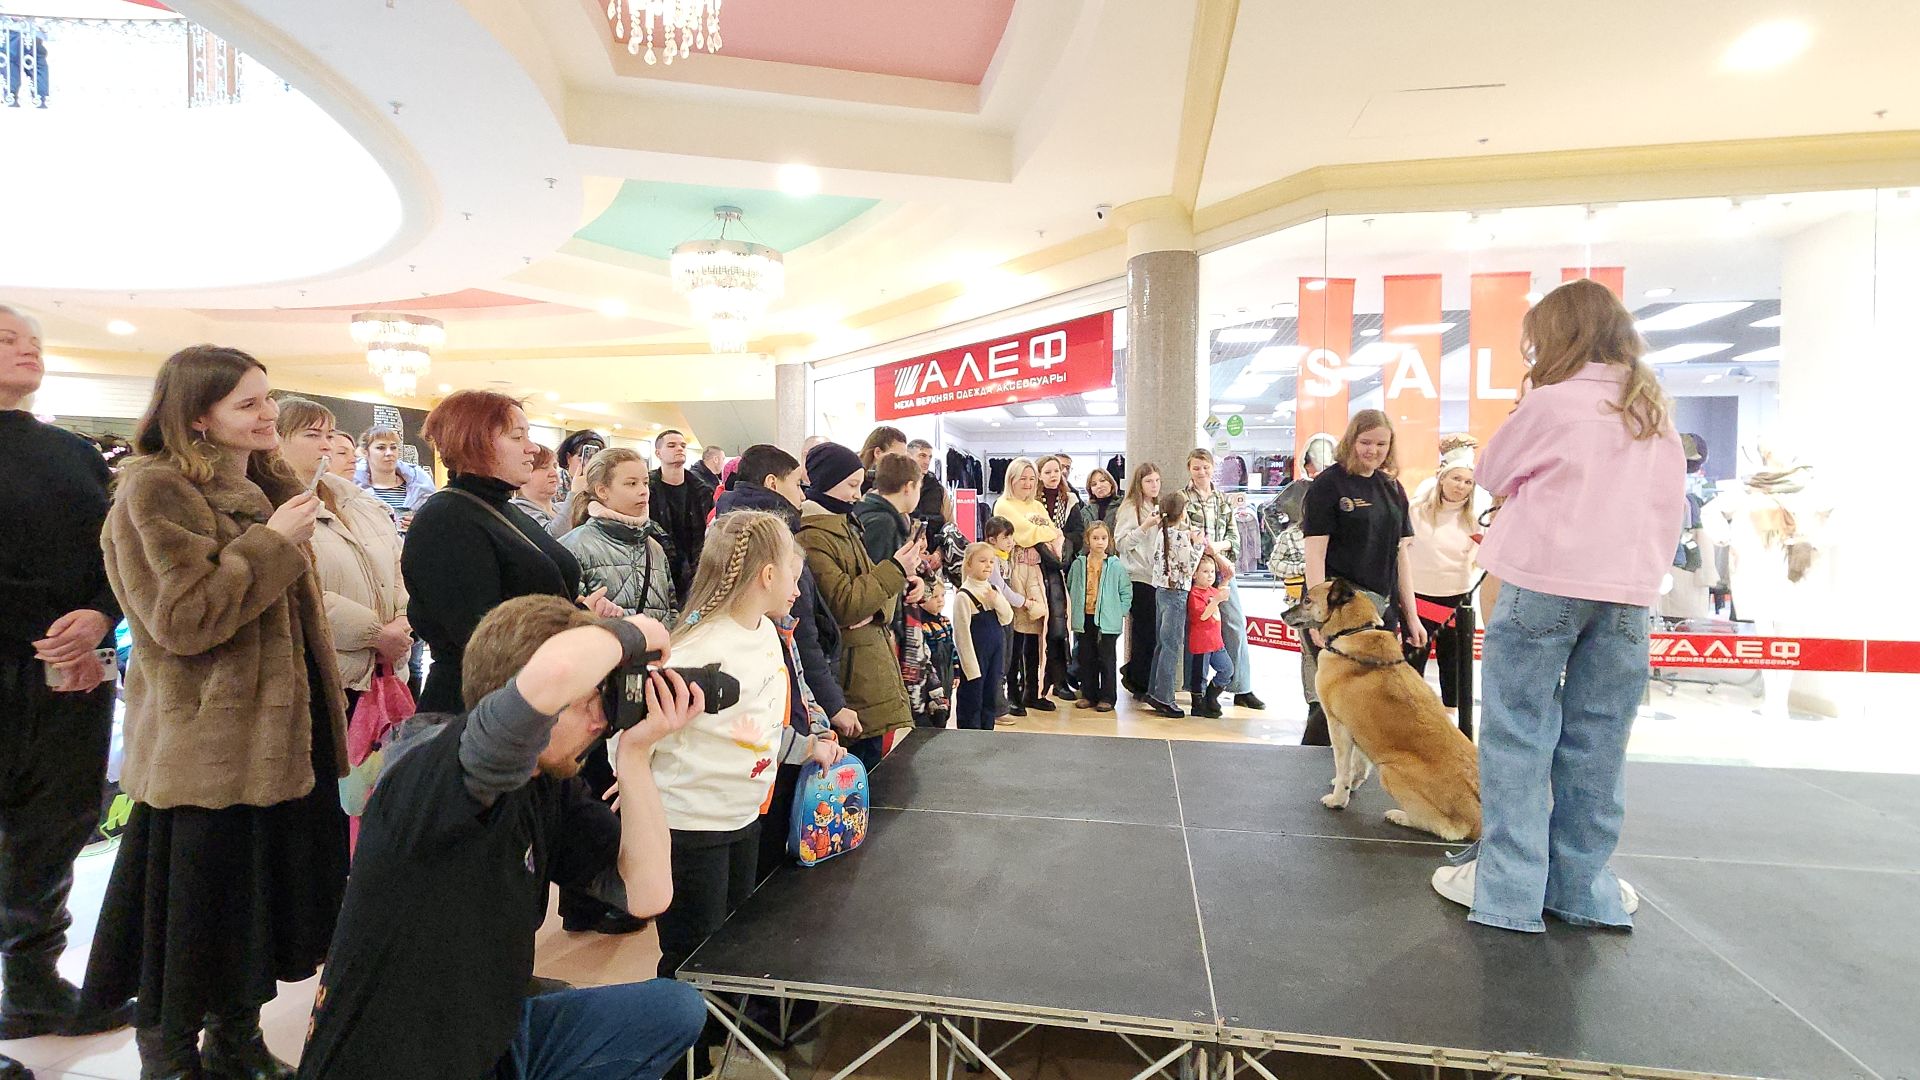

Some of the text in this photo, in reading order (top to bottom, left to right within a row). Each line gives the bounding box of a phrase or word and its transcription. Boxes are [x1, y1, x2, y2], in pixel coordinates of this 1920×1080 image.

[919, 330, 1067, 393] АЛЕФ
[1305, 347, 1517, 399] SAL
[894, 371, 1067, 410] МЕХА ВЕРХНЯЯ ОДЕЖДА АКСЕССУАРЫ
[1669, 638, 1801, 659] АЛЕФ
